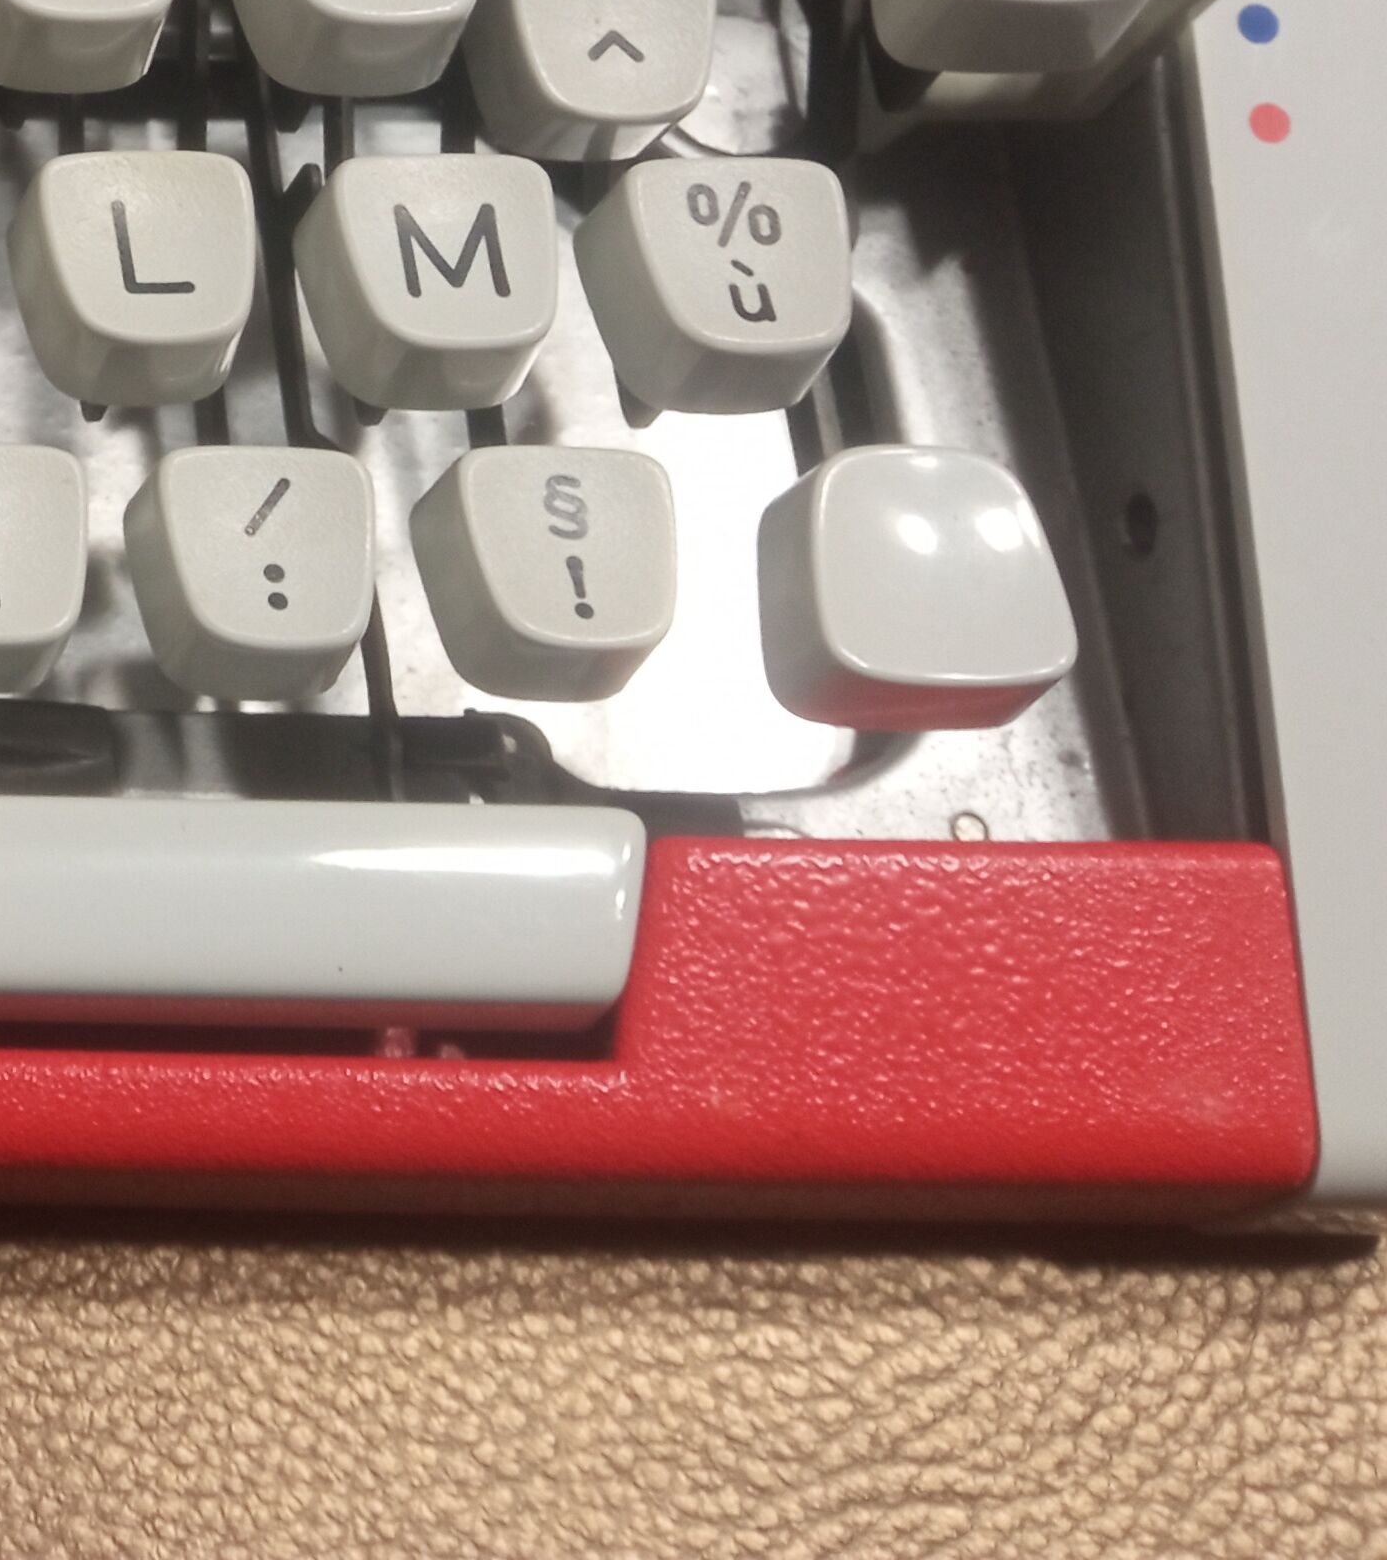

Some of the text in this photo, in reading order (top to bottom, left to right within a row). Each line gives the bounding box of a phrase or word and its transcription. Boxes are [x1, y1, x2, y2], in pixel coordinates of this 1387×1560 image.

[110, 201, 197, 296] L
[685, 179, 783, 249] %
[392, 202, 513, 300] M
[727, 258, 778, 324] ù
[542, 473, 589, 542] §
[564, 554, 596, 621] !
